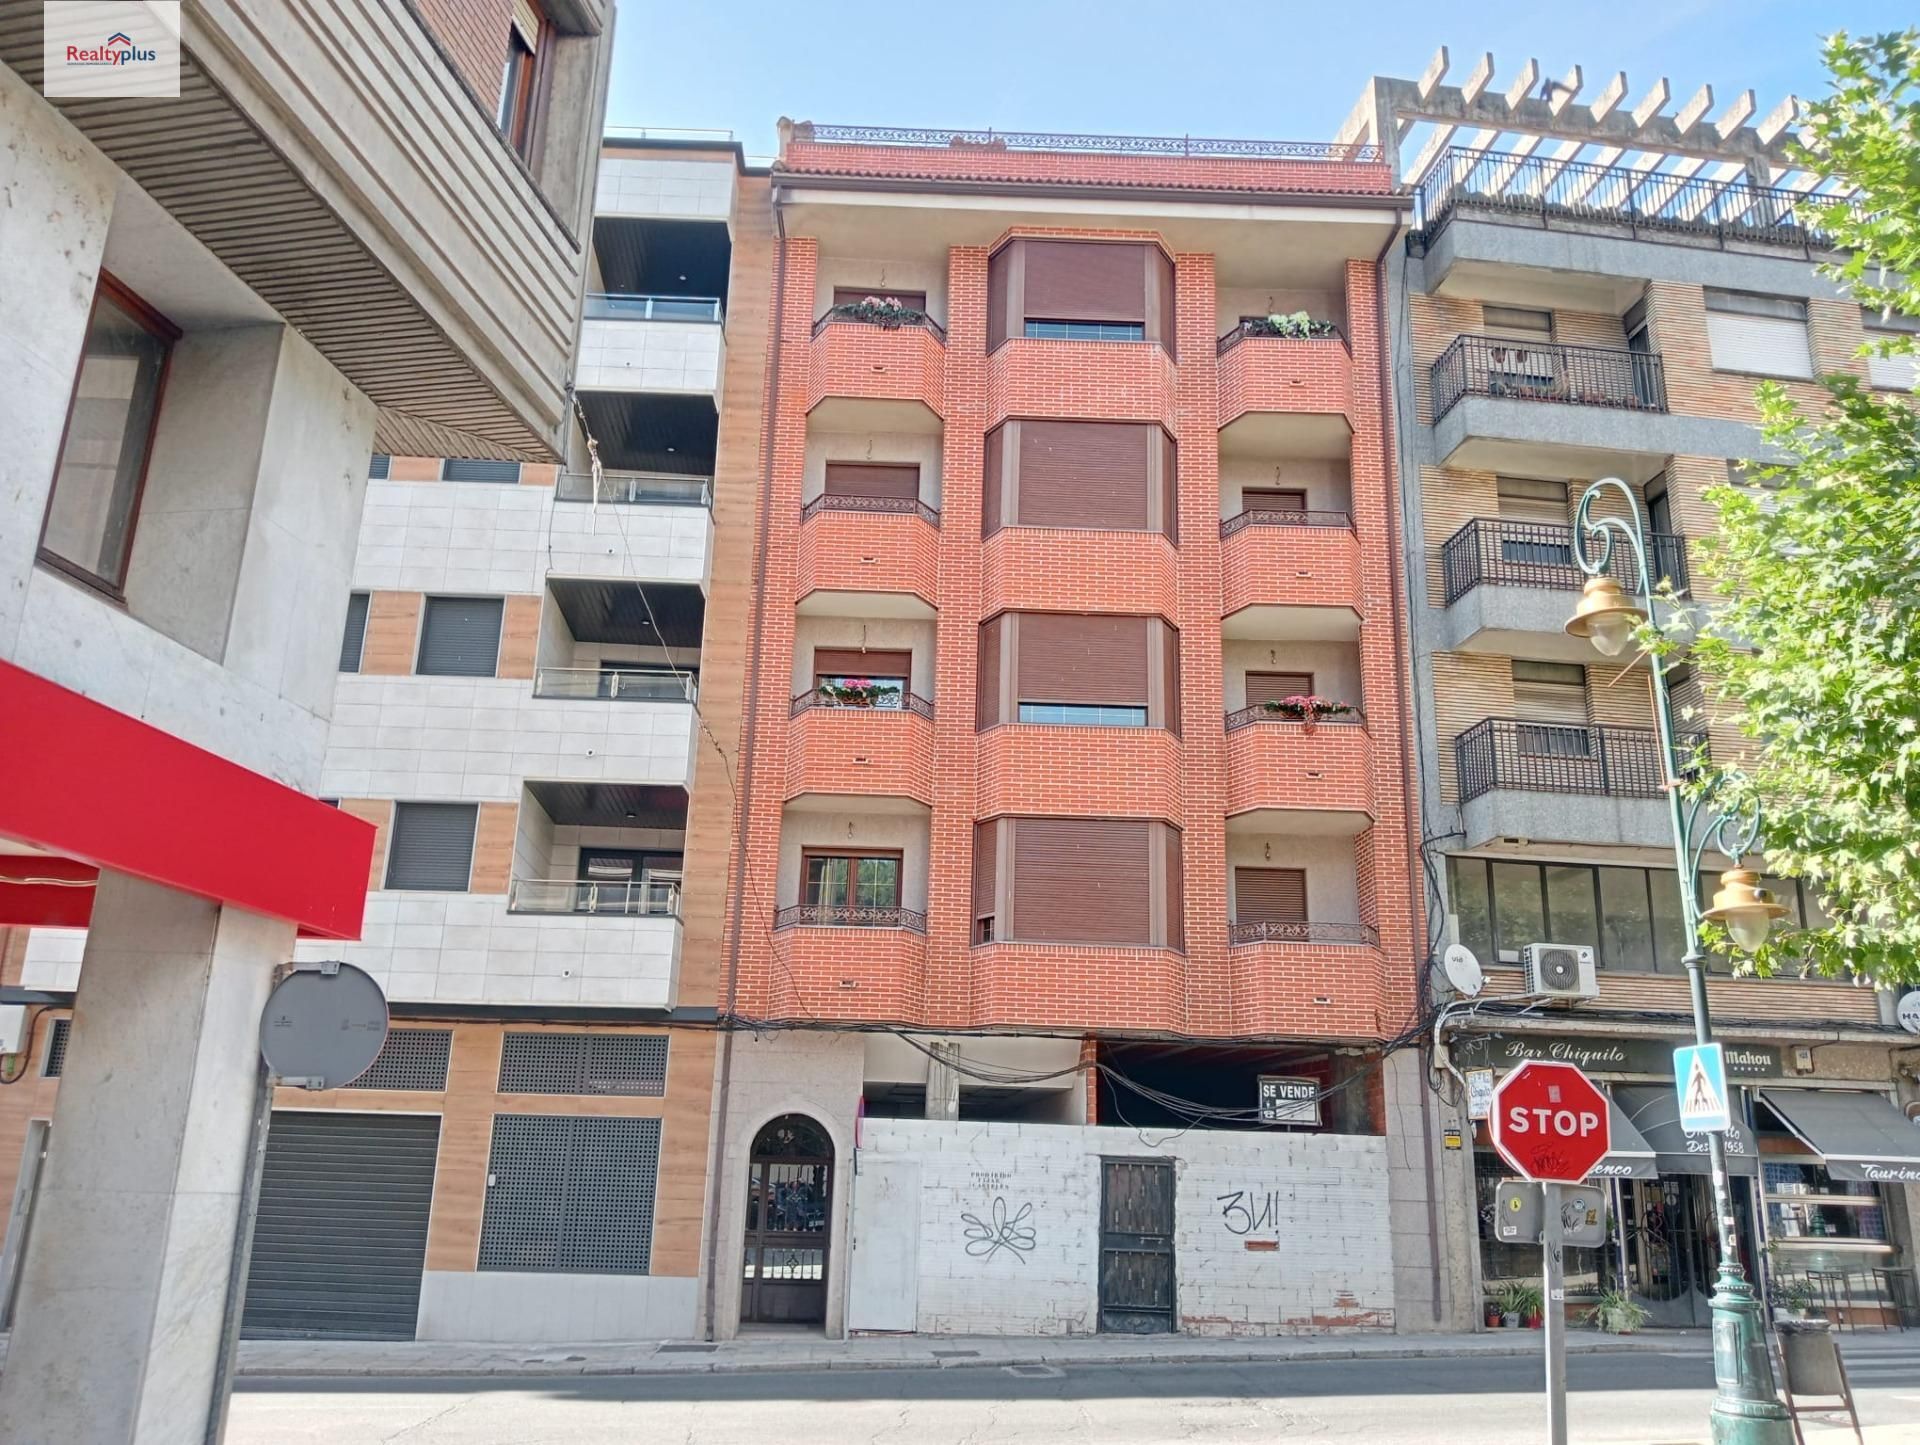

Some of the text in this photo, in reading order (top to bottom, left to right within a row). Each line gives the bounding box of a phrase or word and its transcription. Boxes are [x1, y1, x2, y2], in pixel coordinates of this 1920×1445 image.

[1505, 1041, 1628, 1066] Bar Chiquito
[1725, 1051, 1771, 1066] Mahou
[1263, 1085, 1315, 1099] SE VENDE
[1508, 1106, 1599, 1137] STOP
